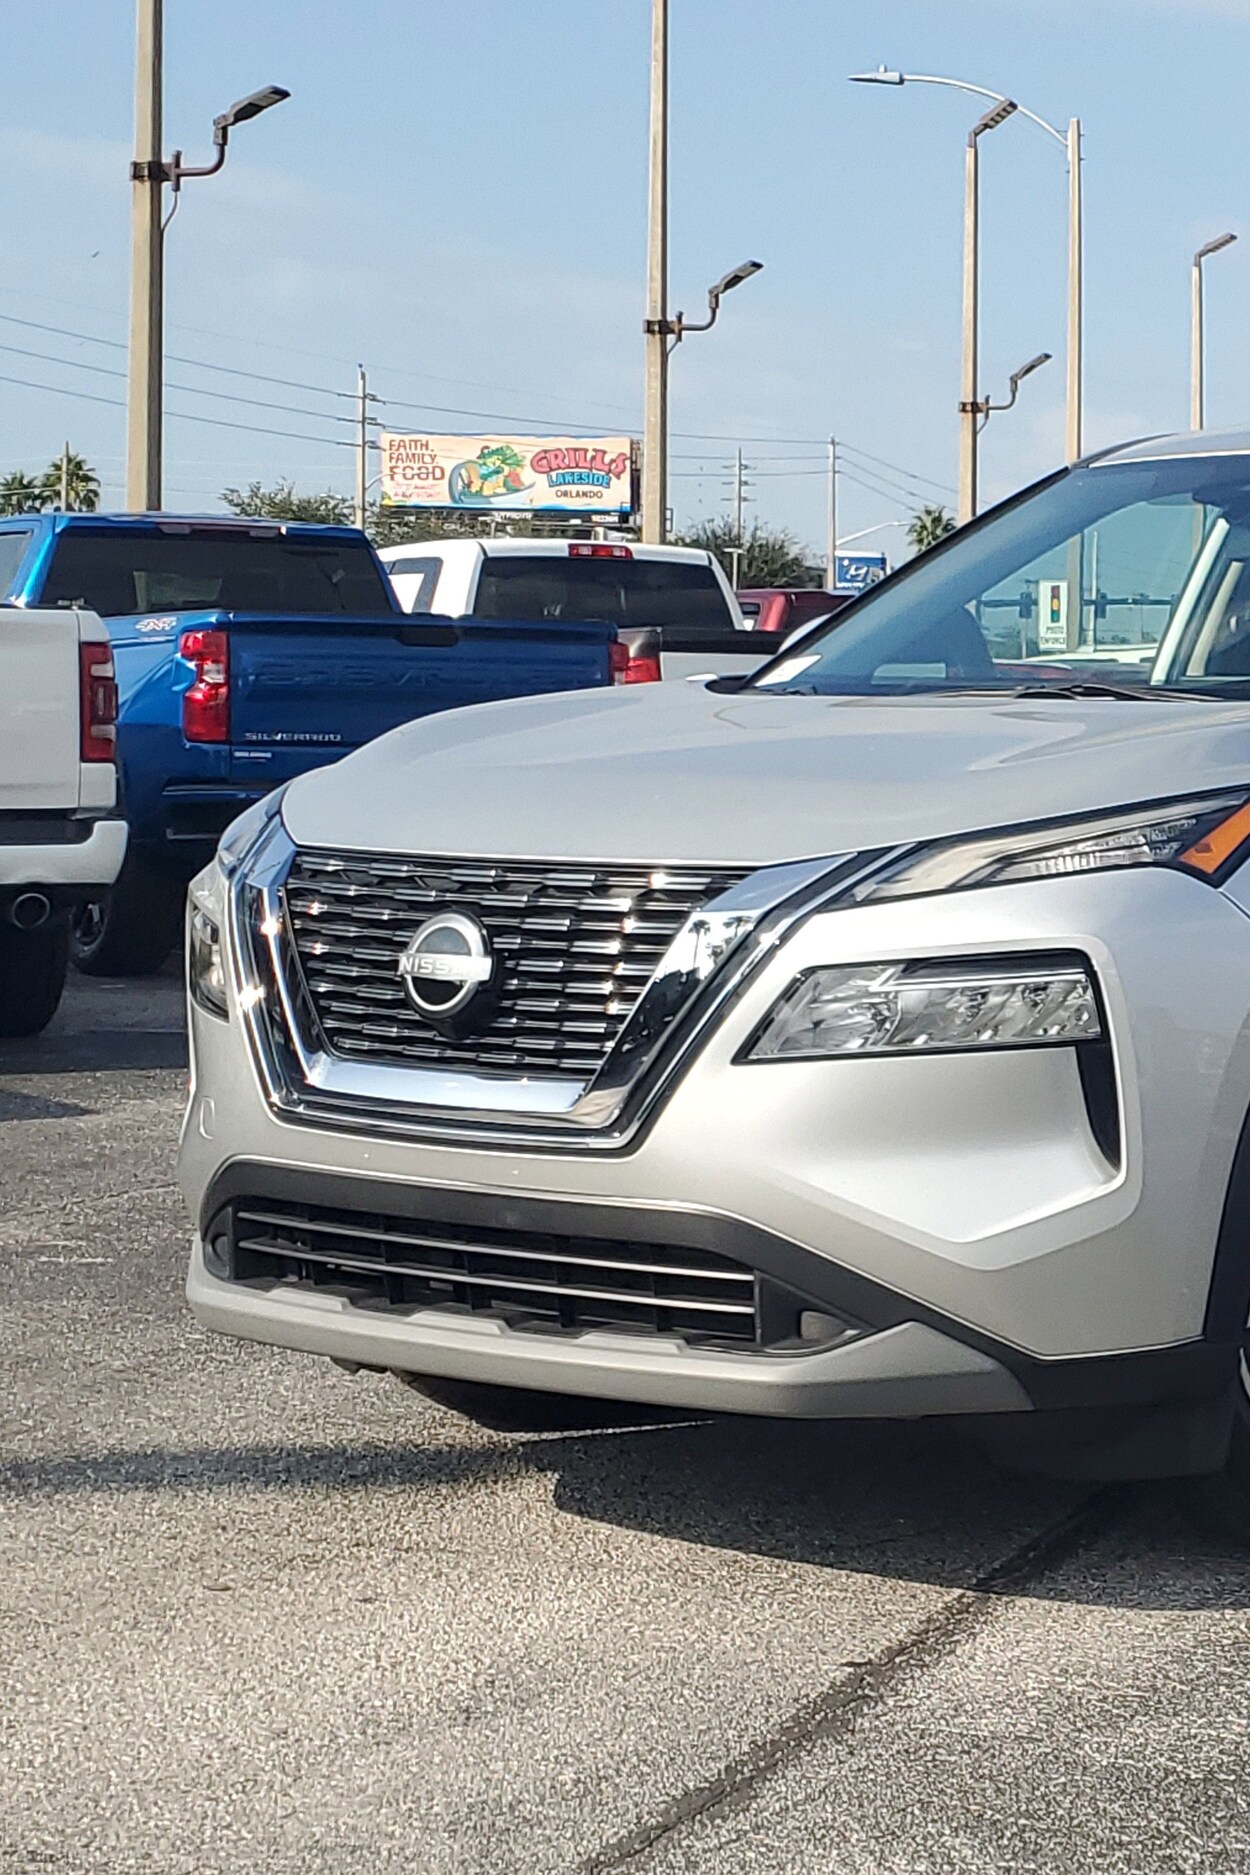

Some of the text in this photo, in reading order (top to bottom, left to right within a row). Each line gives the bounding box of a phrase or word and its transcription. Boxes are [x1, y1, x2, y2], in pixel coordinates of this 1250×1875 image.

[389, 465, 445, 481] FOOD
[547, 471, 612, 489] LAKESIDE
[555, 489, 603, 499] ORLANDO
[244, 732, 342, 742] SILVERADO
